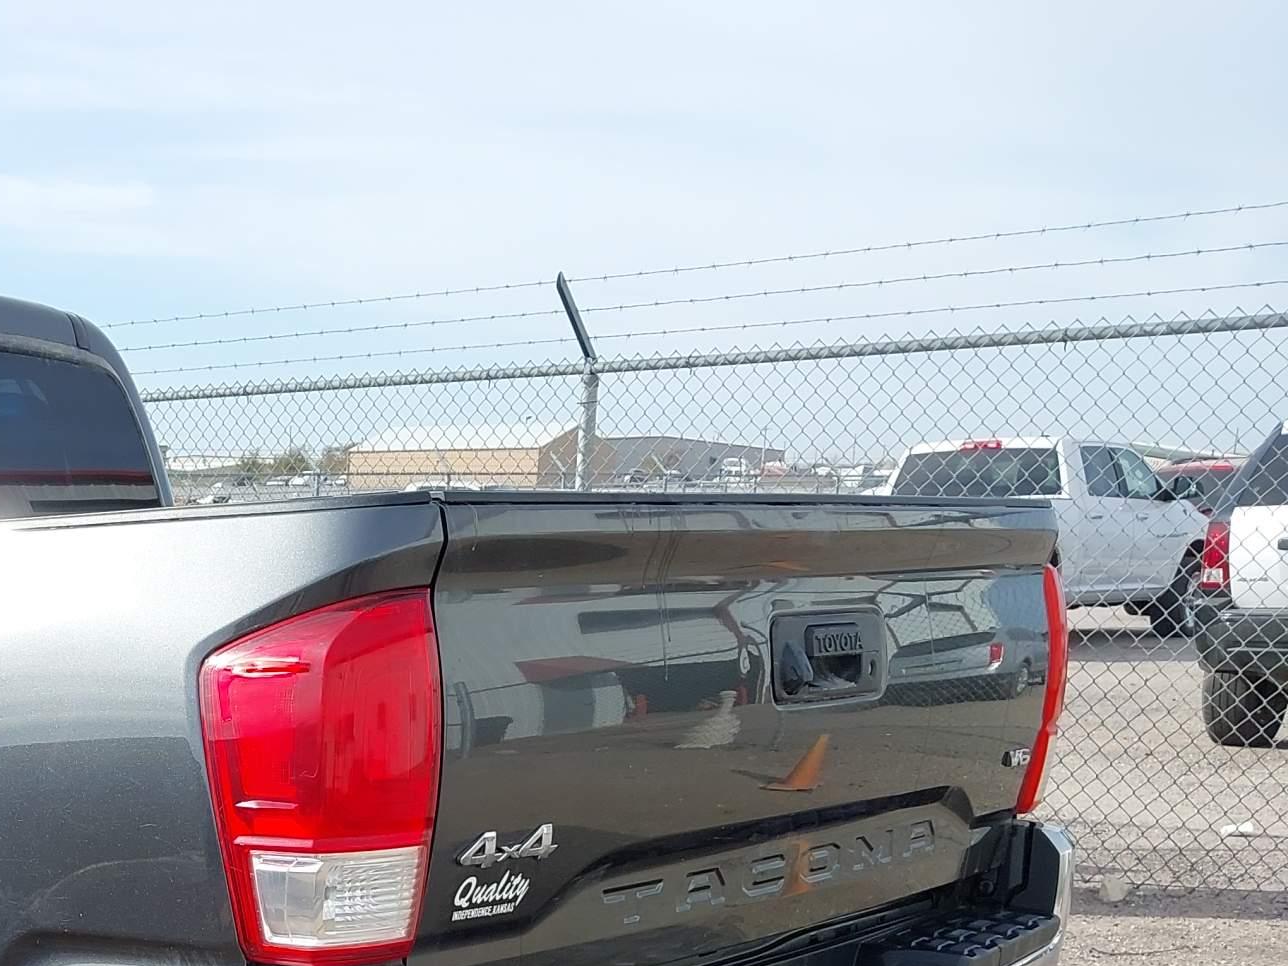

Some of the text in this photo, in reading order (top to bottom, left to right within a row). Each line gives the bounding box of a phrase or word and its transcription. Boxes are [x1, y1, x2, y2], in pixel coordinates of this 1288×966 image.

[813, 631, 864, 655] TOYOTA
[1006, 747, 1032, 768] V6
[457, 822, 559, 869] 4x4
[601, 819, 937, 926] TACOMA
[453, 869, 531, 909] Quality
[491, 901, 516, 916] KANSAS
